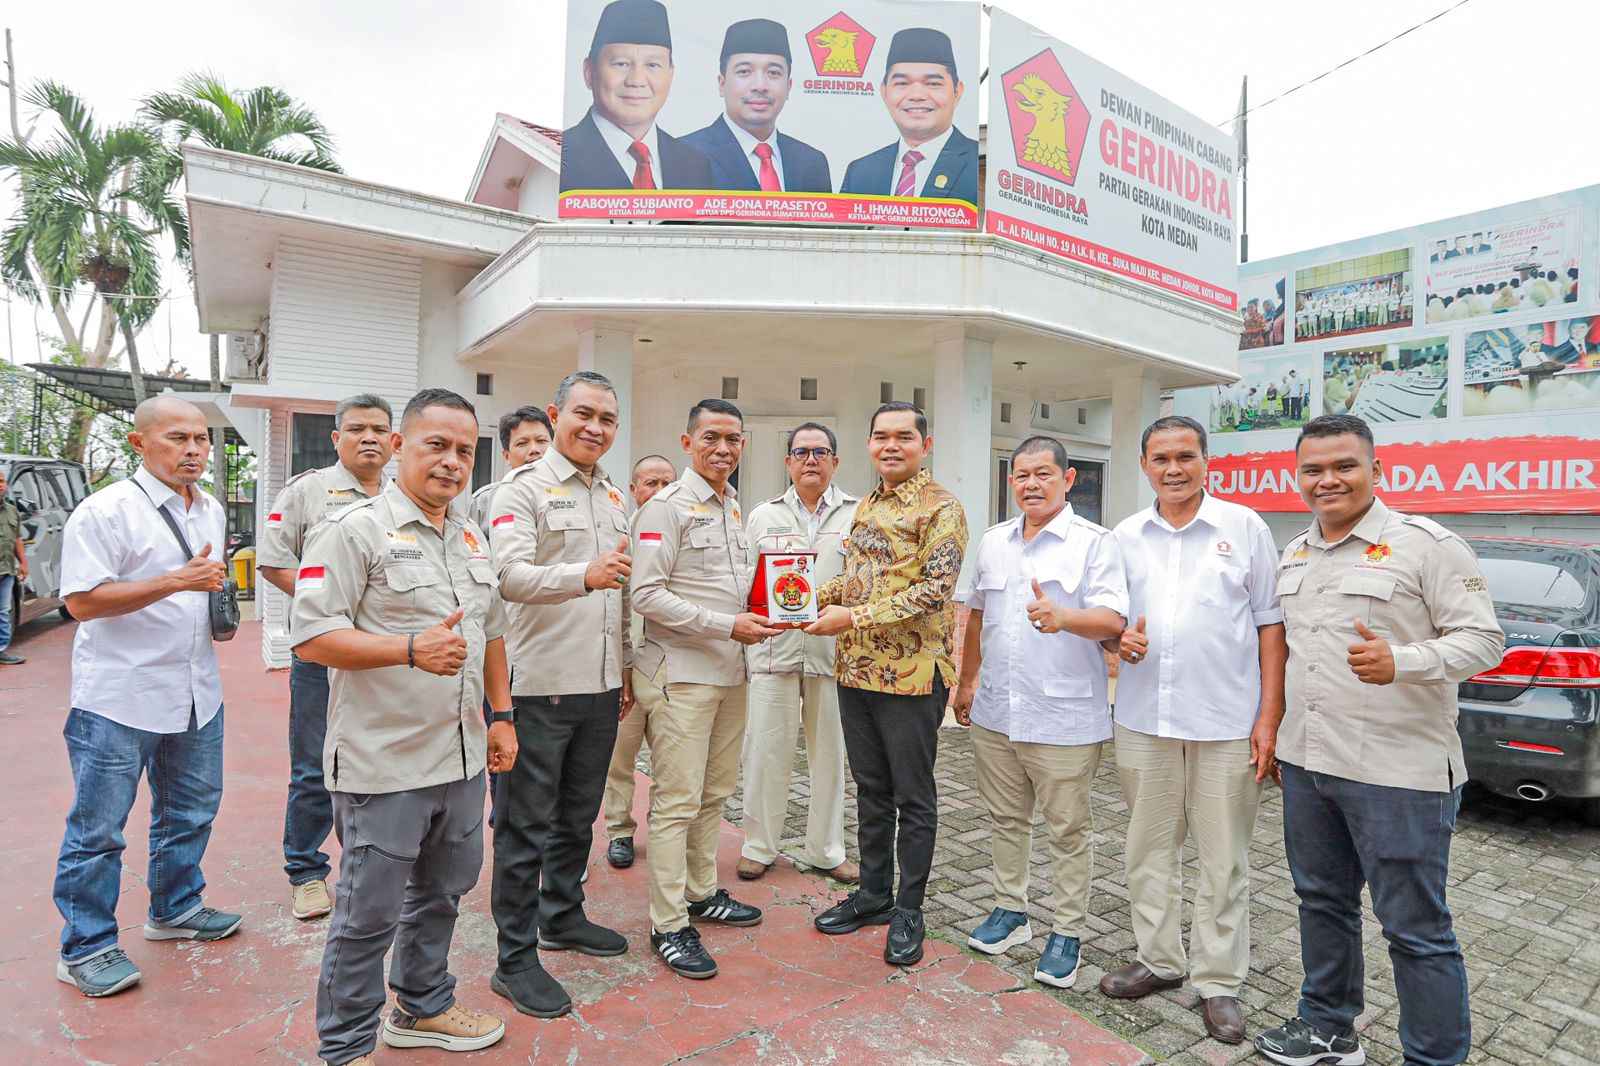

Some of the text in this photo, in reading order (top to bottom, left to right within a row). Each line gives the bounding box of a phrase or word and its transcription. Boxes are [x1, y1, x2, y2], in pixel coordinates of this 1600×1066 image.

[803, 79, 875, 92] GERINDRA
[1100, 88, 1232, 174] DEWAN PIMPINAN CABANG
[1099, 118, 1232, 220] GERINDRA
[565, 198, 694, 209] PRABOWO SUBIANTO
[704, 198, 828, 212] ADE JONA PRASETYO
[853, 203, 966, 219] H. IHWAN RITONGA
[998, 169, 1088, 217] GERINDRA
[998, 189, 1089, 226] GERAKAN INDONESIA RAYA
[1099, 171, 1232, 243] PARTAI GERAKAN INDONESIA RAYA
[888, 215, 923, 223] GERINDRA
[1141, 213, 1198, 252] KOTA MEDAN
[996, 220, 1008, 234] JL.
[1009, 224, 1020, 238] AL
[1021, 227, 1045, 245] FALAH
[1046, 235, 1060, 250] NO.
[1060, 240, 1070, 252] 19
[1070, 243, 1076, 255] A
[1077, 246, 1088, 258] LK.
[1097, 251, 1112, 266] KEL.
[1112, 256, 1130, 271] SUKA
[1130, 262, 1147, 276] MAJU
[1147, 268, 1160, 281] KEC.
[1161, 272, 1181, 288] MEDAN
[1181, 280, 1200, 296] JOHOR,
[1201, 285, 1215, 300] KOTA
[1215, 290, 1232, 305] MEDAN
[1204, 459, 1597, 494] RJUAN ADA AKHIR
